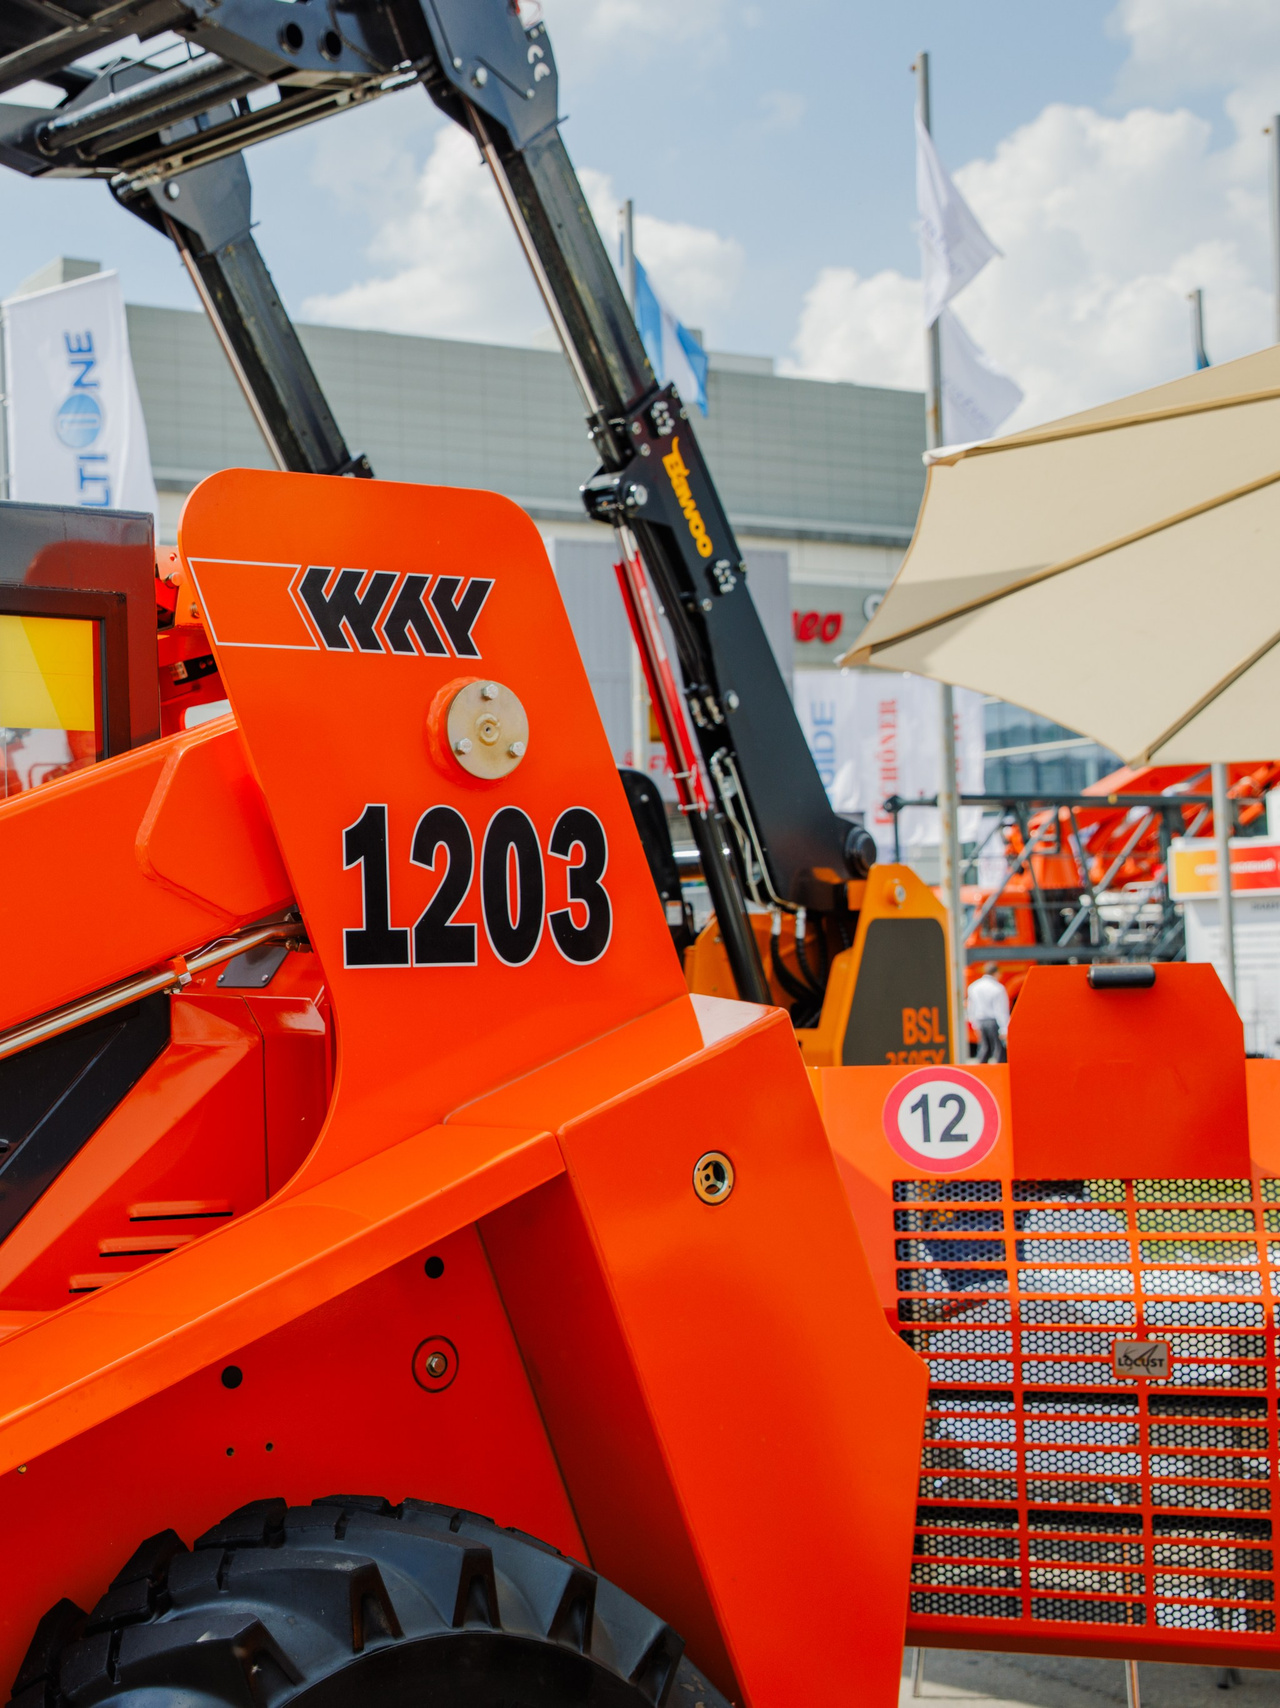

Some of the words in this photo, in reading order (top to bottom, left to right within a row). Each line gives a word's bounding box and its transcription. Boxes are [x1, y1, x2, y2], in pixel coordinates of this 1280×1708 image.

[297, 564, 496, 660] WAY
[342, 803, 614, 970] 1203
[901, 1006, 946, 1046] BSL
[910, 1093, 969, 1144] 12
[1118, 1357, 1165, 1368] LOCUST
